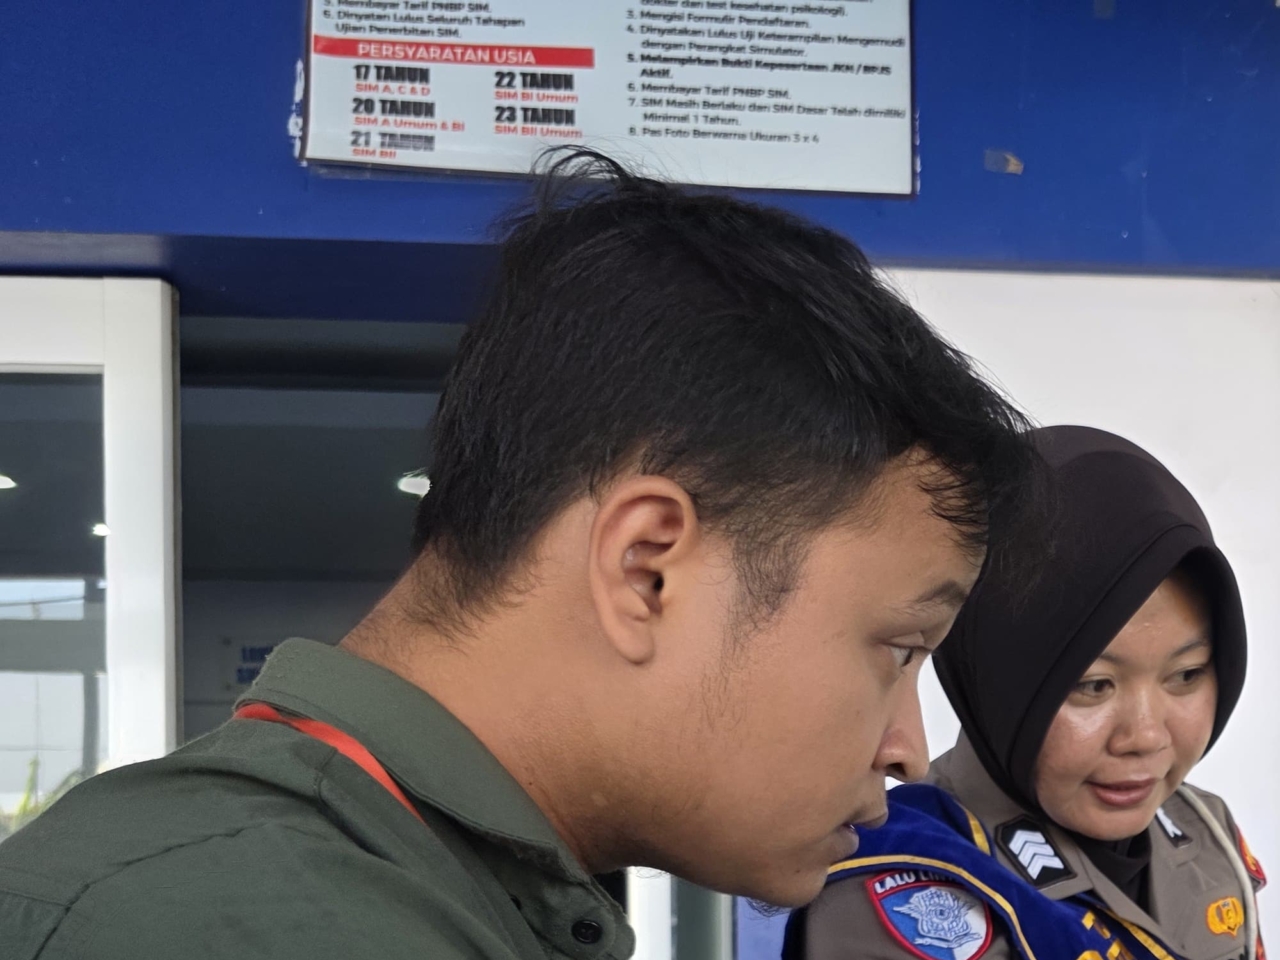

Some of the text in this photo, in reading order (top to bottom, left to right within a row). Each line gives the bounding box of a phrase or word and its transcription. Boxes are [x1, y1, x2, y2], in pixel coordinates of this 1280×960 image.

[358, 42, 535, 64] PERSYARATAN USIA
[354, 64, 429, 83] 17 TAHUN
[495, 72, 573, 90] 22 TAHUN
[494, 90, 518, 100] SIM
[537, 93, 577, 103] Umum
[353, 97, 435, 118] 20 TAHUN
[495, 106, 575, 125] 23 TAHUN
[351, 131, 435, 151] 21 TAHUN
[495, 125, 517, 134] SIM
[540, 127, 582, 138] Umum
[875, 872, 916, 893] LALU
